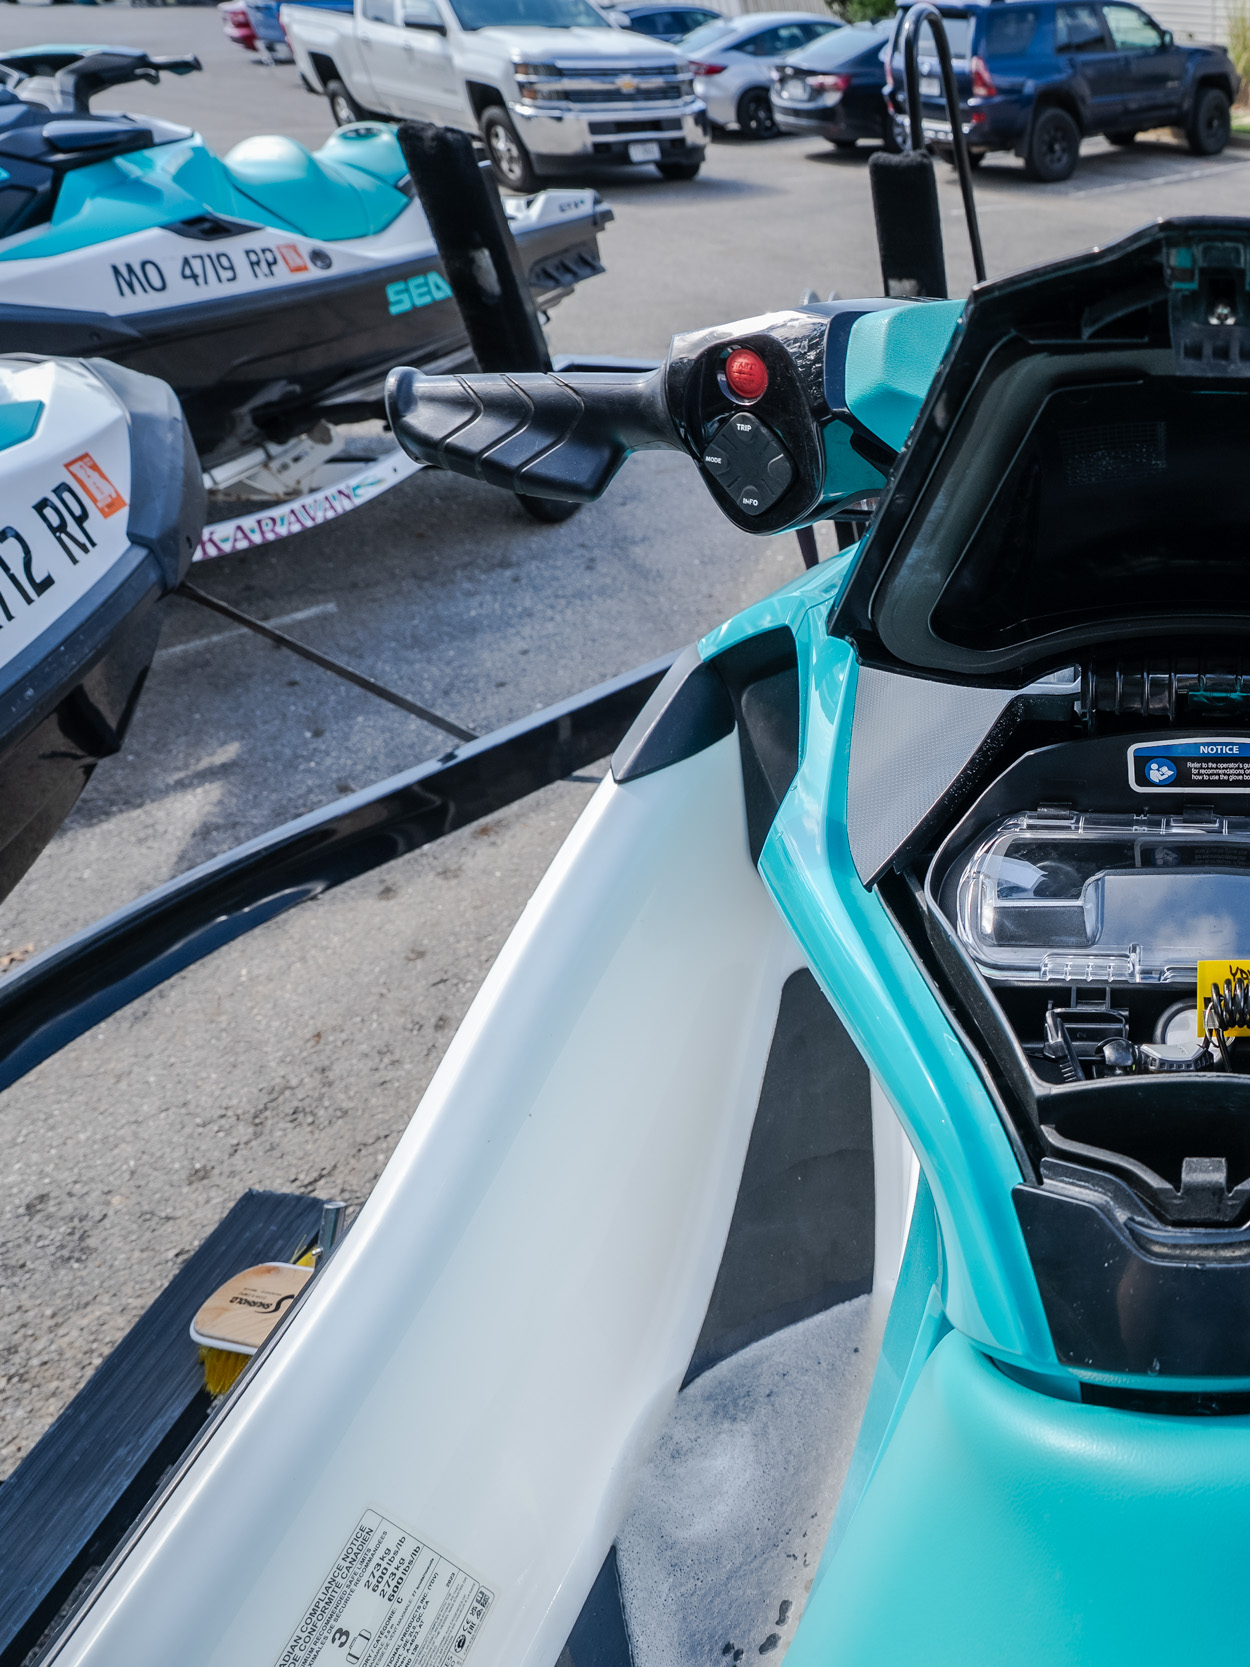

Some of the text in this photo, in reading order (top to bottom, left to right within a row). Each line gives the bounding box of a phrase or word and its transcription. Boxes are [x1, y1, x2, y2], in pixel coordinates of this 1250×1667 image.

[111, 260, 168, 297] MO
[181, 252, 237, 287] 4719
[244, 248, 278, 279] RP
[737, 423, 752, 432] TRIP
[705, 456, 722, 464] MODE
[32, 481, 98, 566] RP
[201, 484, 356, 558] KARAVAN
[743, 498, 758, 506] INFO
[1200, 745, 1239, 754] NOTICE
[299, 1562, 344, 1634] COMPLIANCE
[341, 1523, 367, 1562] NOTICE
[326, 1622, 335, 1634] DE
[352, 1529, 388, 1587] RECOMMANDÉES
[363, 1546, 391, 1589] 273 kg
[370, 1534, 406, 1593] 600 lbs/lb
[378, 1556, 406, 1598] 273 kg
[386, 1544, 420, 1602] 600 lbs/lb
[296, 1579, 343, 1652] CONFORMITÉ
[339, 1527, 373, 1580] CANADIEN
[312, 1589, 347, 1646] RECOMMENDED
[345, 1570, 358, 1589] SAFE
[356, 1547, 371, 1570] LIMITS
[396, 1596, 403, 1604] C
[329, 1624, 351, 1649] 3
[399, 1604, 422, 1642] PRODUCTS
